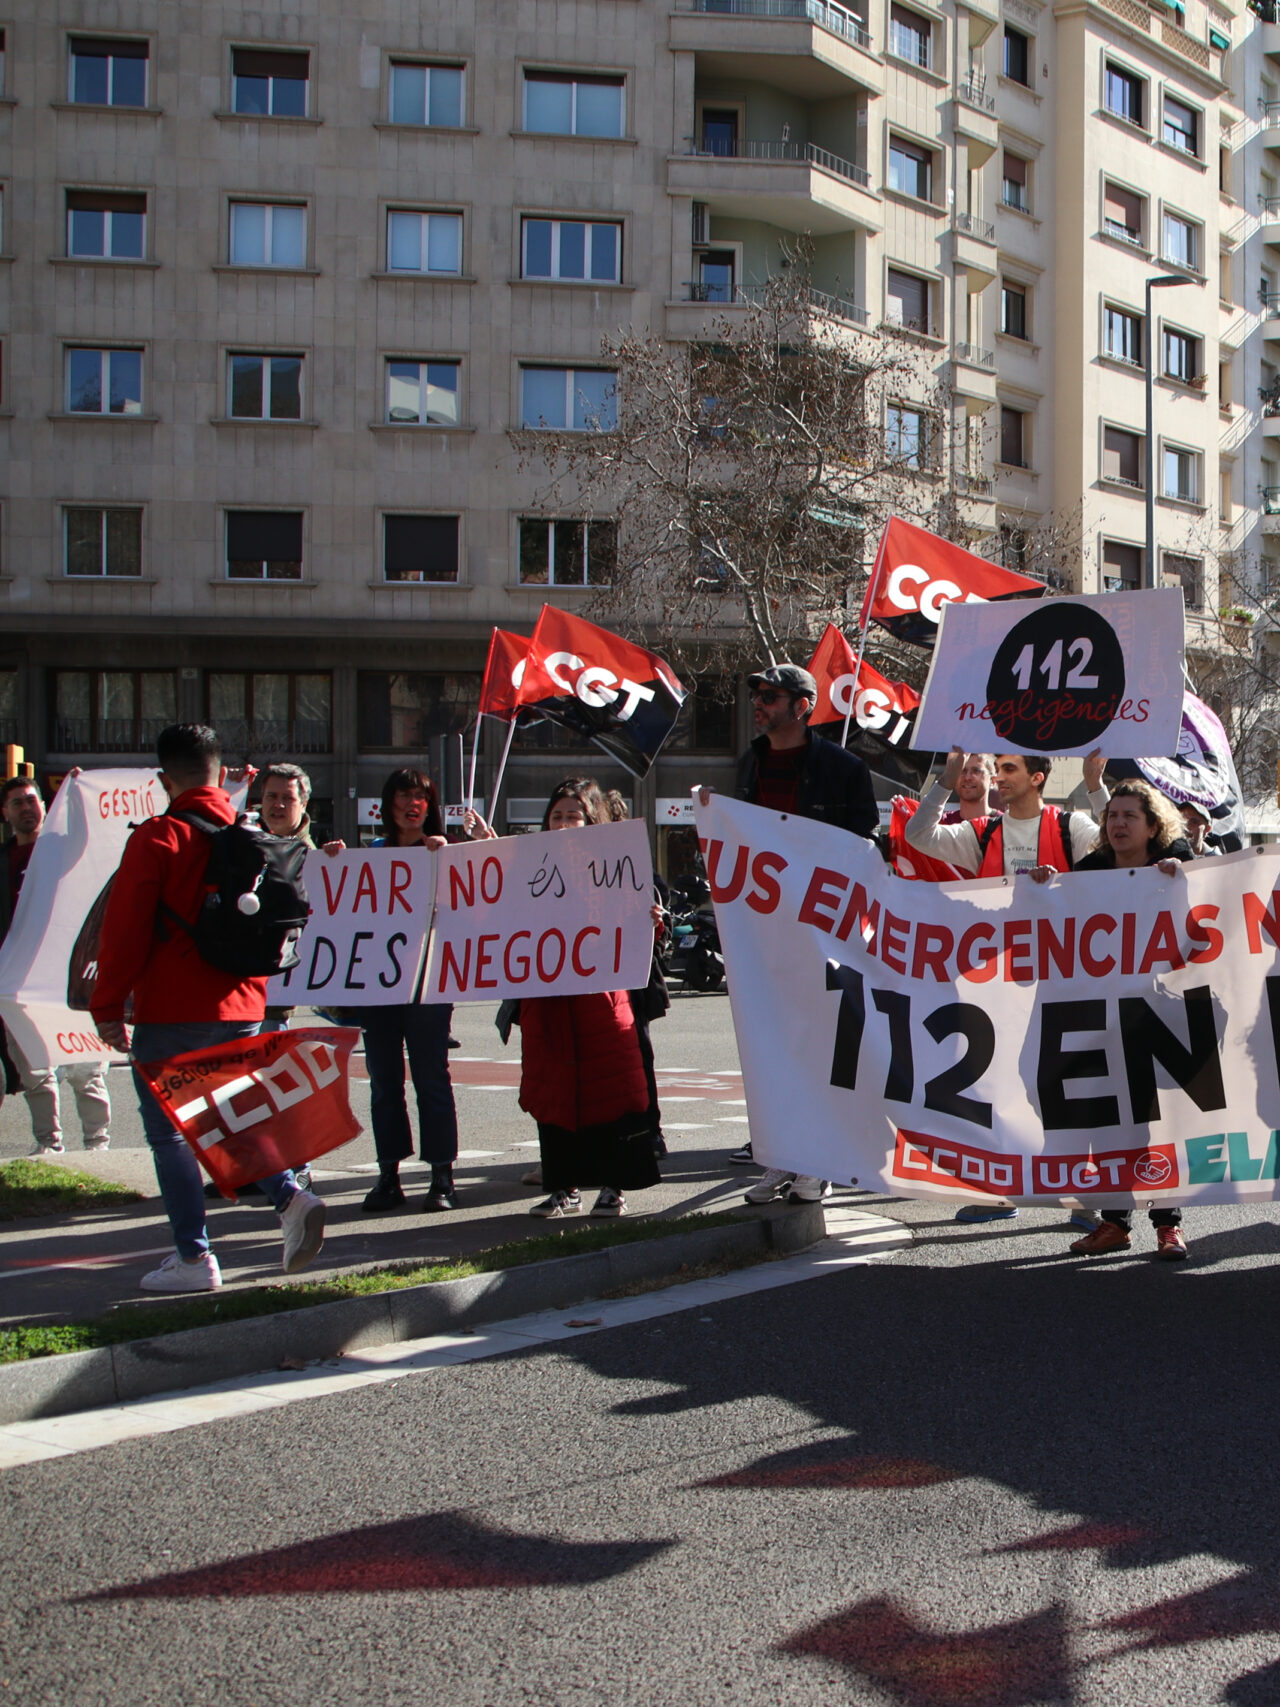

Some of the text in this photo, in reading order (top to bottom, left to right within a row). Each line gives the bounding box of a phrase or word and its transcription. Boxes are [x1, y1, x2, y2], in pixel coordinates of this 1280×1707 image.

[888, 564, 990, 623] CG
[544, 651, 655, 721] CGT
[1011, 637, 1099, 690] 112
[955, 690, 1150, 740] negligències
[308, 860, 413, 916] VAR
[449, 853, 644, 911] NO és un
[798, 866, 1224, 985] EMERGENCIAS
[438, 926, 622, 993] NEGOCI
[826, 961, 996, 1130] 112
[1037, 984, 1227, 1131] EN
[902, 1142, 1013, 1187] CCOO
[1039, 1157, 1127, 1189] UGT
